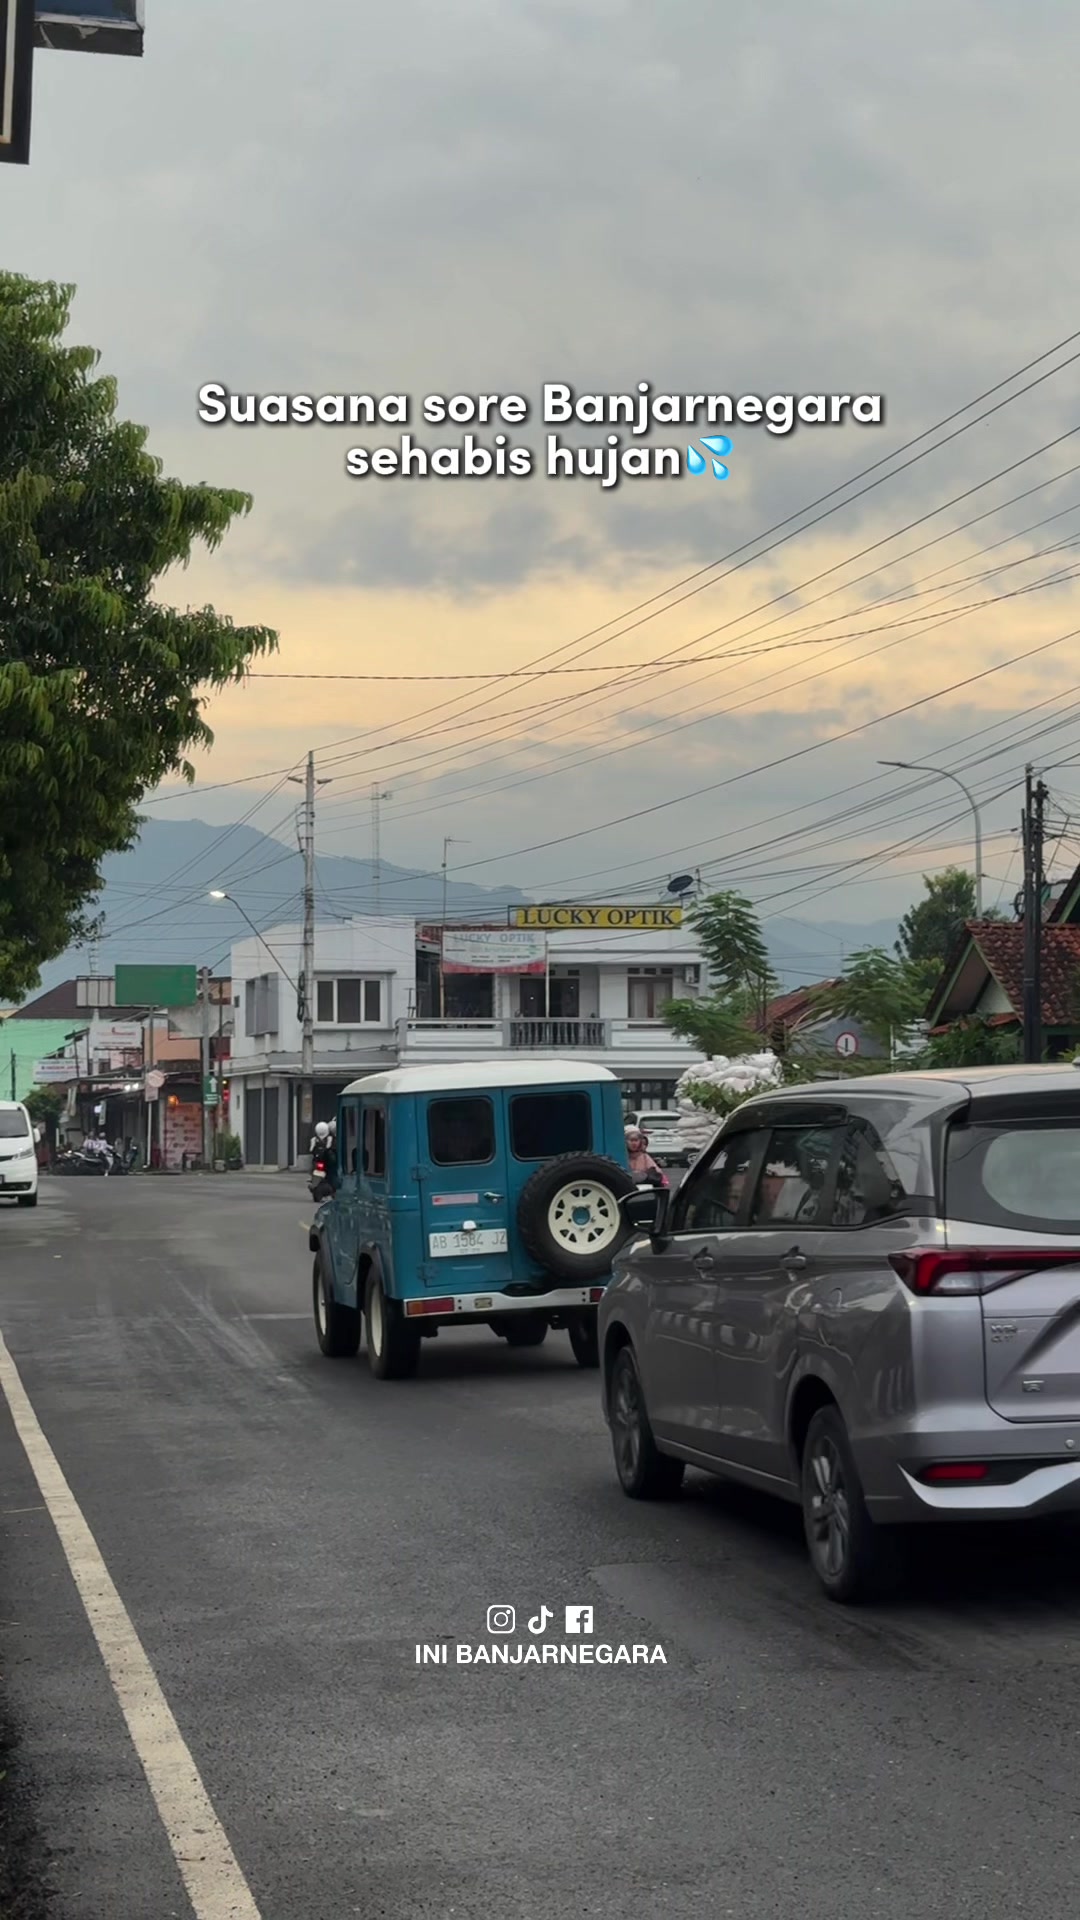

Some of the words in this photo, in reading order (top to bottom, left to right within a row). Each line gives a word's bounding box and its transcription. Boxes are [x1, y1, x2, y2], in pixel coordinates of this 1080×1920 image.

[523, 908, 602, 925] LUCKY
[607, 908, 675, 925] OPTIK
[453, 933, 492, 943] LUCKY
[500, 933, 535, 943] OPTIK
[432, 1236, 448, 1249] AB
